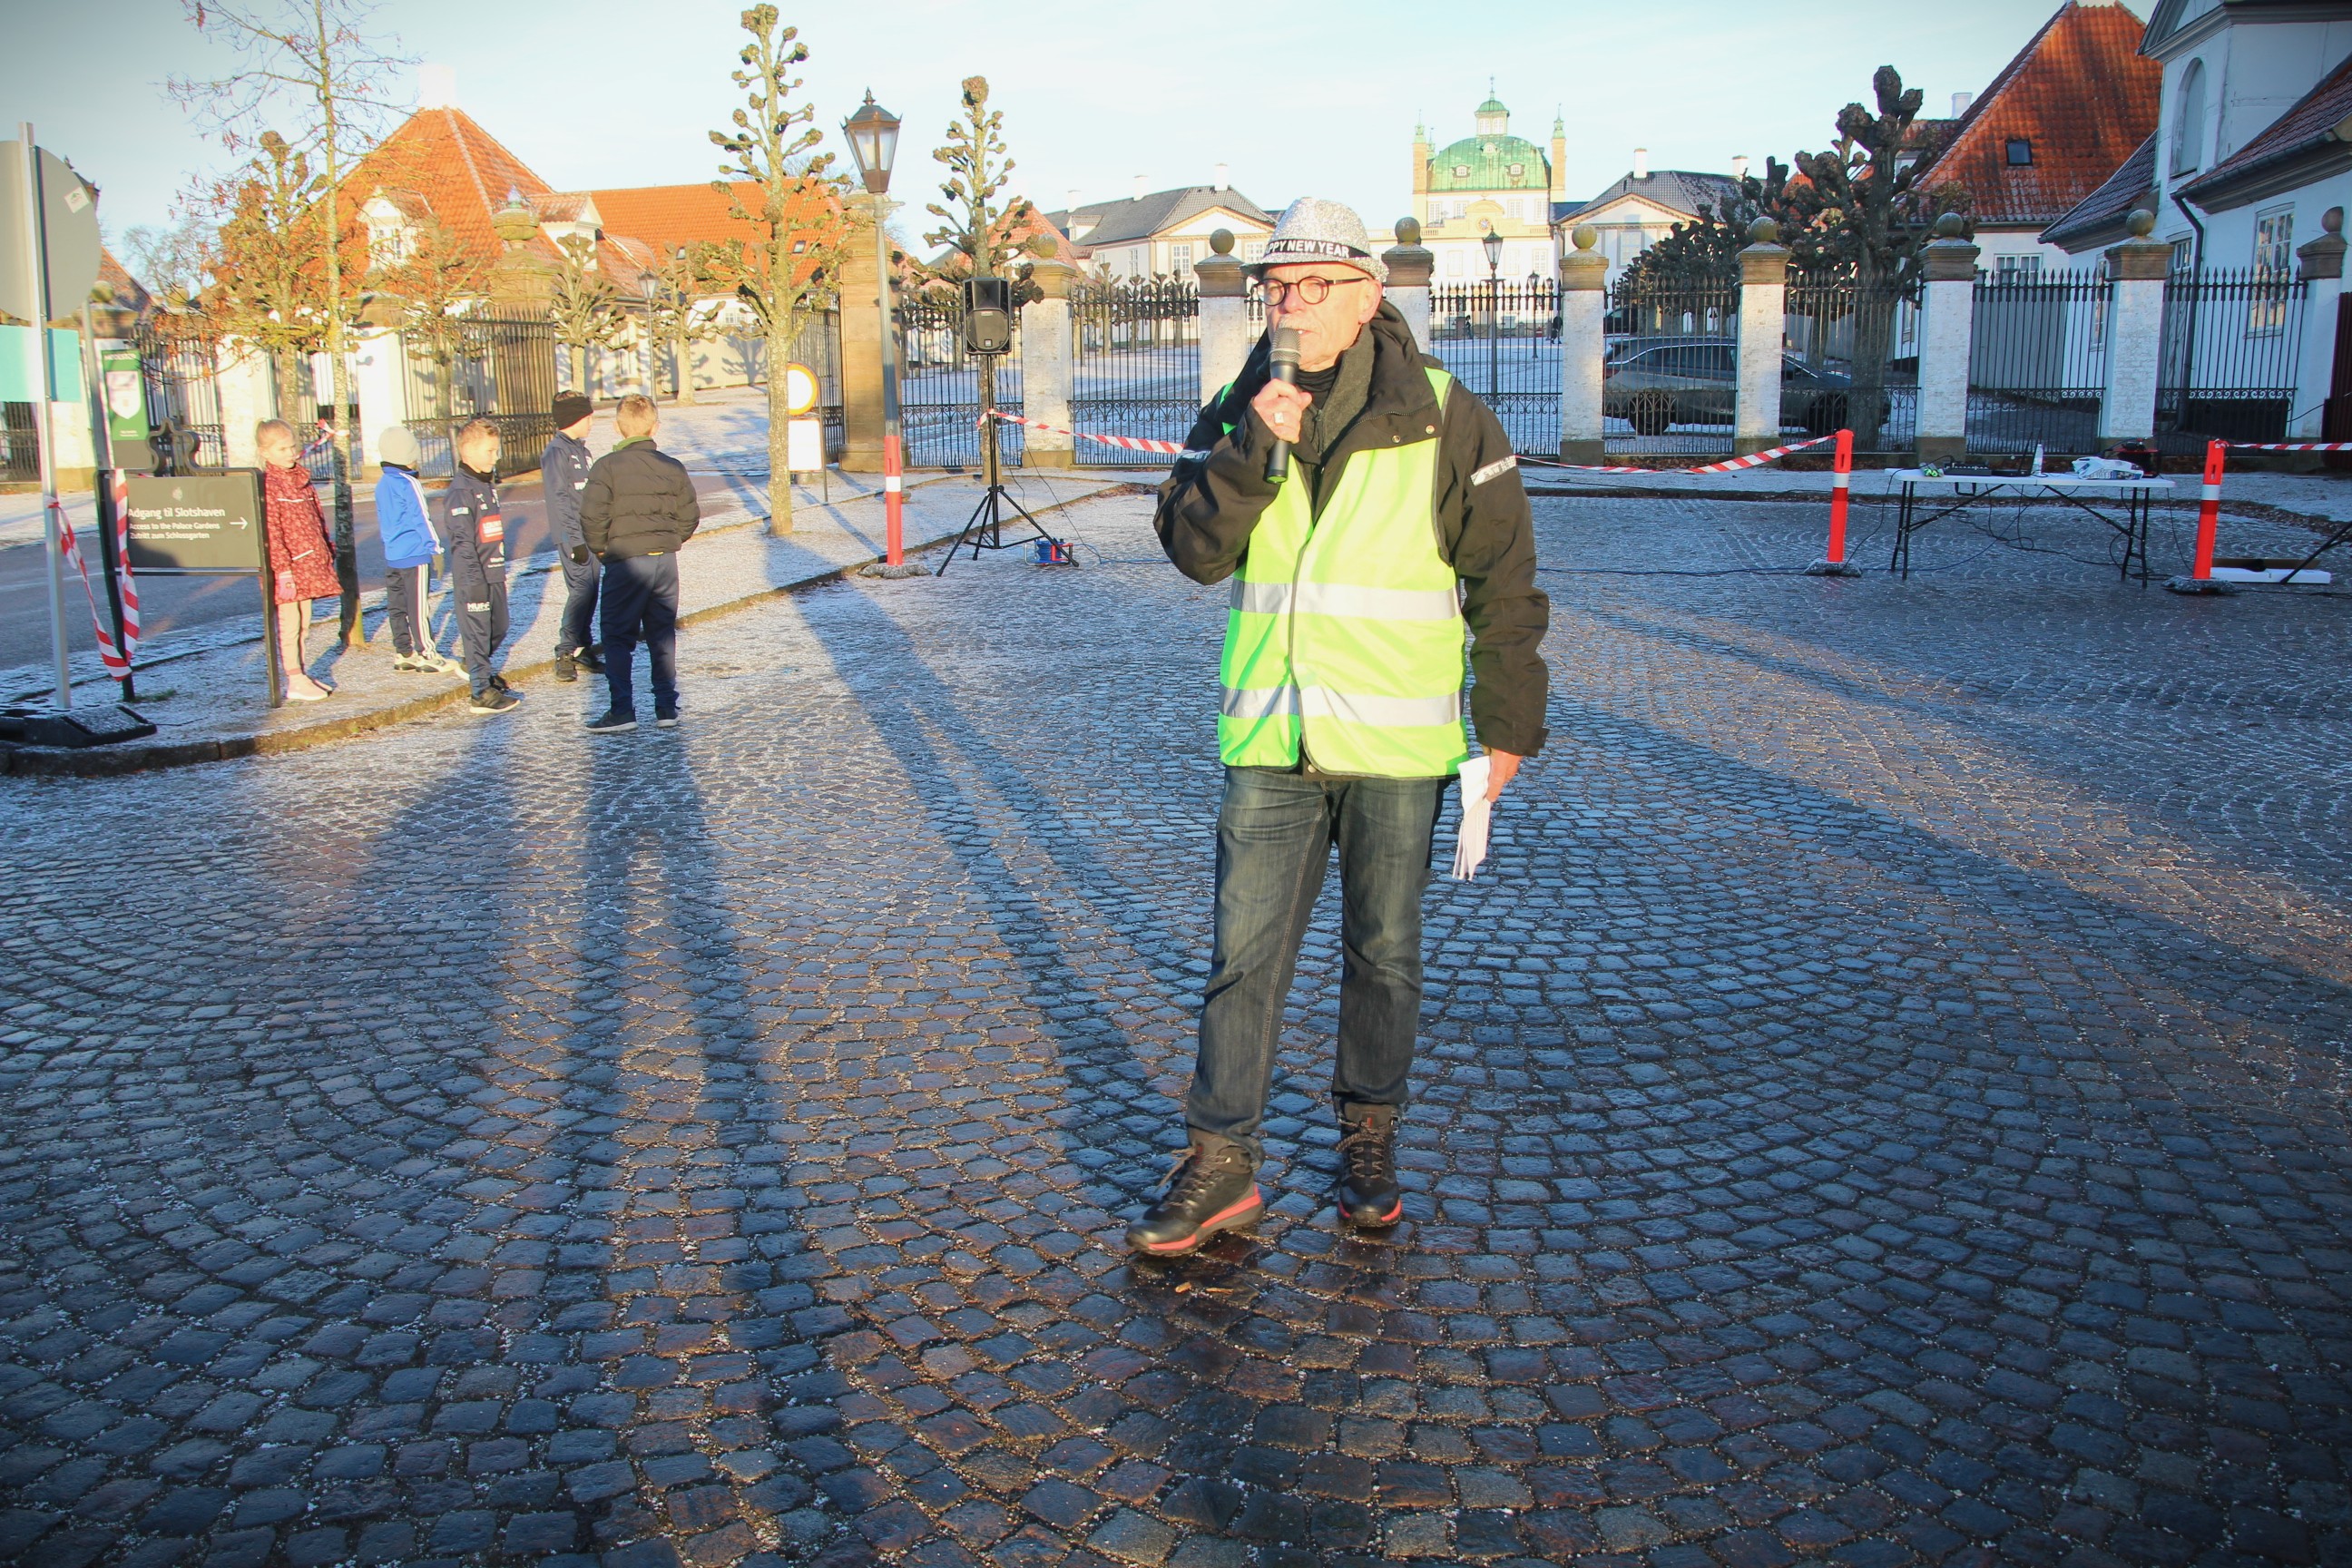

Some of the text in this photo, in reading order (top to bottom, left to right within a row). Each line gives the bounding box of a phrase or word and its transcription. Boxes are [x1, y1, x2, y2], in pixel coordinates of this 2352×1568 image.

[1287, 240, 1316, 252] NEW
[1318, 241, 1349, 258] YEAR
[128, 507, 225, 519] Adgang til Slotshaven
[165, 532, 210, 540] Schlossgarten
